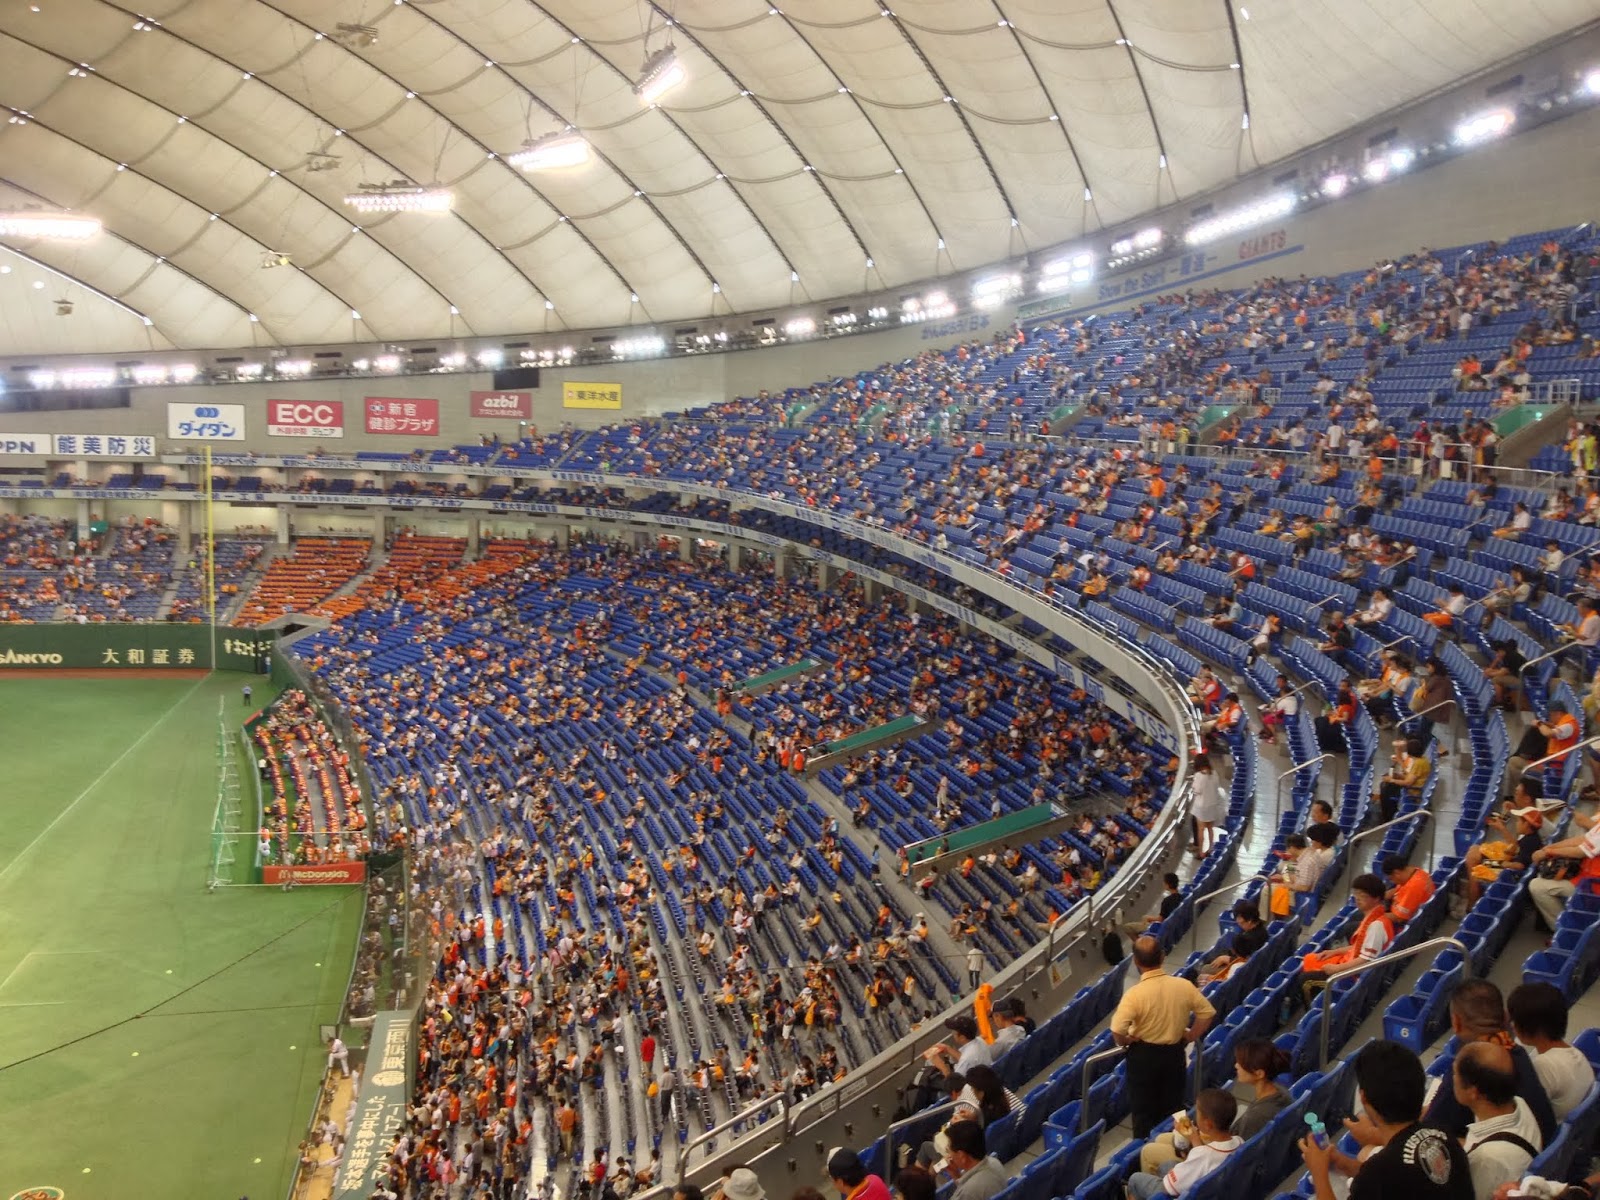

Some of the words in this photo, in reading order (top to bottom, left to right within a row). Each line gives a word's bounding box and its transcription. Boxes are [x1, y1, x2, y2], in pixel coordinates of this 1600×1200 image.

[483, 394, 519, 409] azbil
[276, 403, 334, 425] ECC
[388, 402, 417, 417] 新宿
[178, 420, 236, 437] ダイダン
[57, 435, 152, 456] 能美防災
[401, 463, 434, 472] DUSKIN
[102, 648, 195, 664] 大和証券
[292, 870, 350, 879] McDonald's
[1401, 1027, 1409, 1038] 6
[381, 1018, 411, 1071] 東京西川
